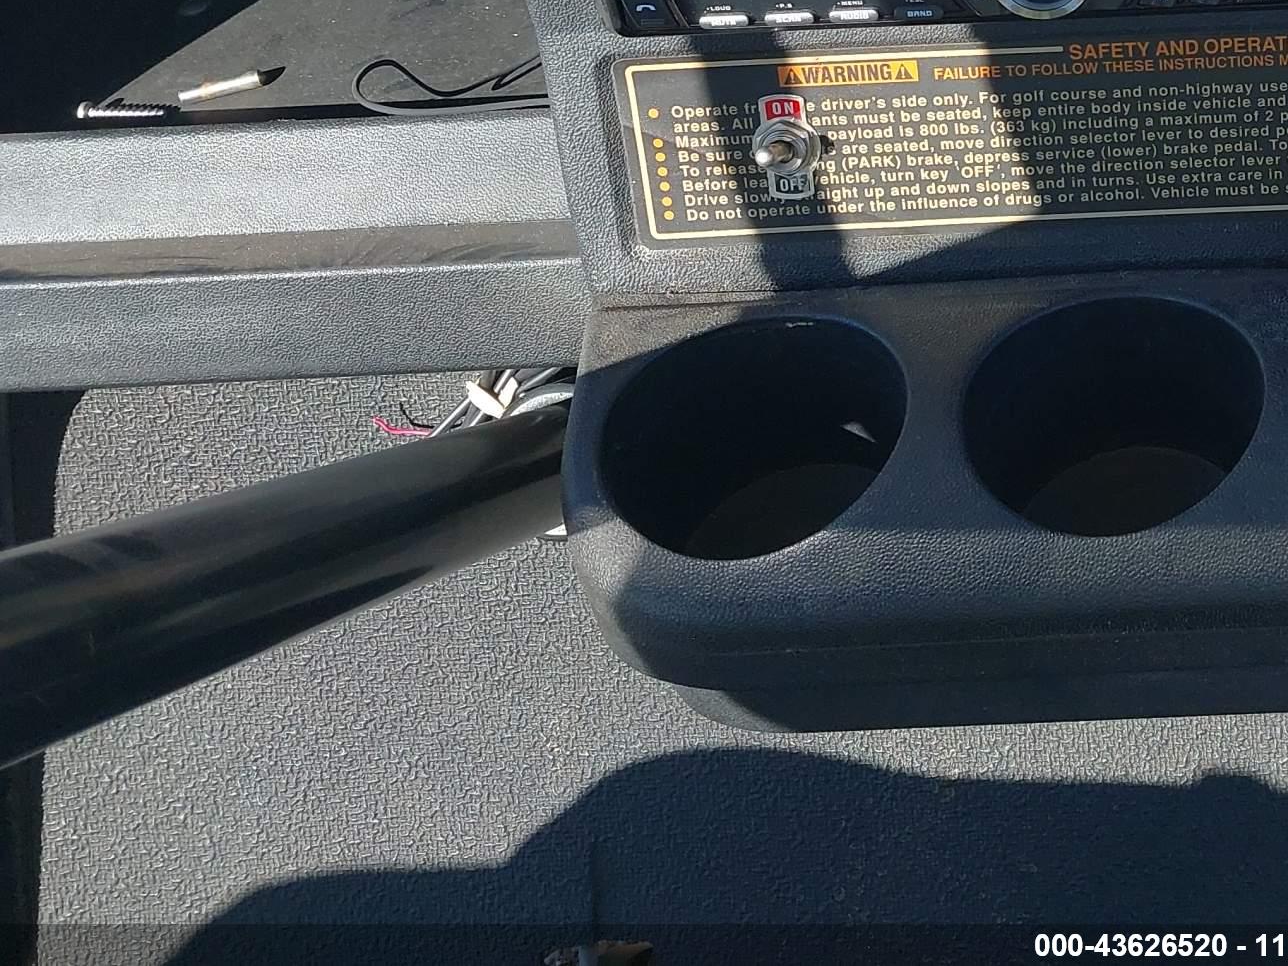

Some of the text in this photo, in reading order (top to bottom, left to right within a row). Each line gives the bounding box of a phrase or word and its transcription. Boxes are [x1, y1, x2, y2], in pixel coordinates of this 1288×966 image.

[1069, 42, 1149, 60] SAFETY
[1156, 40, 1198, 56] AND
[801, 63, 892, 83] WARNING
[934, 66, 1001, 81] FAILURE
[1006, 65, 1026, 77] TO
[1032, 62, 1098, 76] FOLLOW
[1104, 59, 1154, 73] THESE
[1159, 54, 1274, 71] INSTRUCTIONS
[671, 104, 737, 120] Operate
[821, 96, 886, 112] driver's
[892, 95, 928, 108] side
[932, 93, 973, 107] only.
[979, 91, 1007, 104] For
[1013, 89, 1044, 105] golf
[1051, 88, 1106, 101] course
[1113, 86, 1142, 99] and
[1149, 82, 1253, 97] non-highway
[1259, 81, 1288, 92] use
[674, 120, 725, 133] areas.
[854, 111, 895, 124] must
[901, 109, 921, 123] be
[926, 107, 987, 122] seated,
[992, 105, 1031, 120] keep
[1038, 103, 1085, 116] entire
[1092, 101, 1131, 115] body
[1137, 99, 1187, 112] inside
[1193, 96, 1251, 109] vehicle
[1257, 94, 1287, 108] and
[772, 102, 794, 114] ON
[678, 151, 700, 162] Be
[705, 150, 743, 160] sure
[842, 144, 868, 154] are
[874, 140, 935, 153] seated,
[940, 137, 985, 150] move
[990, 135, 1063, 149] direction
[1070, 131, 1136, 144] selector
[1142, 129, 1182, 141] lever
[1210, 125, 1269, 139] desired
[827, 125, 894, 142] payload
[919, 124, 949, 136] 800
[955, 121, 985, 135] lbs.
[991, 120, 1025, 135] (363
[1063, 115, 1139, 130] including
[1160, 111, 1237, 125] maximum
[680, 165, 700, 177] To
[842, 155, 901, 171] (PARK)
[907, 153, 959, 167] brake,
[964, 151, 1030, 166] depress
[1036, 147, 1095, 160] service
[1101, 144, 1157, 160] (lower)
[1163, 143, 1208, 155] brake
[1214, 140, 1263, 156] pedal.
[682, 179, 738, 192] Before
[881, 171, 914, 182] turn
[920, 165, 949, 182] key
[1011, 164, 1054, 177] move
[1061, 161, 1086, 173] the
[1092, 159, 1164, 172] direction
[1170, 156, 1235, 169] selector
[1241, 155, 1281, 166] lever
[684, 194, 728, 206] Drive
[891, 184, 921, 196] and
[926, 181, 970, 194] down
[975, 179, 1030, 196] slopes
[1036, 178, 1065, 190] and
[1092, 175, 1140, 187] turns.
[1146, 173, 1176, 185] Use
[1182, 172, 1222, 182] extra
[686, 210, 709, 221] Do
[713, 207, 742, 219] not
[748, 204, 811, 219] operate
[817, 200, 864, 214] under
[870, 199, 896, 212] the
[902, 196, 978, 210] influence
[1005, 193, 1052, 208] drugs
[1080, 189, 1145, 202] alcohol.
[1150, 186, 1209, 199] Vehicle
[1216, 183, 1255, 196] must
[780, 178, 807, 192] OFF
